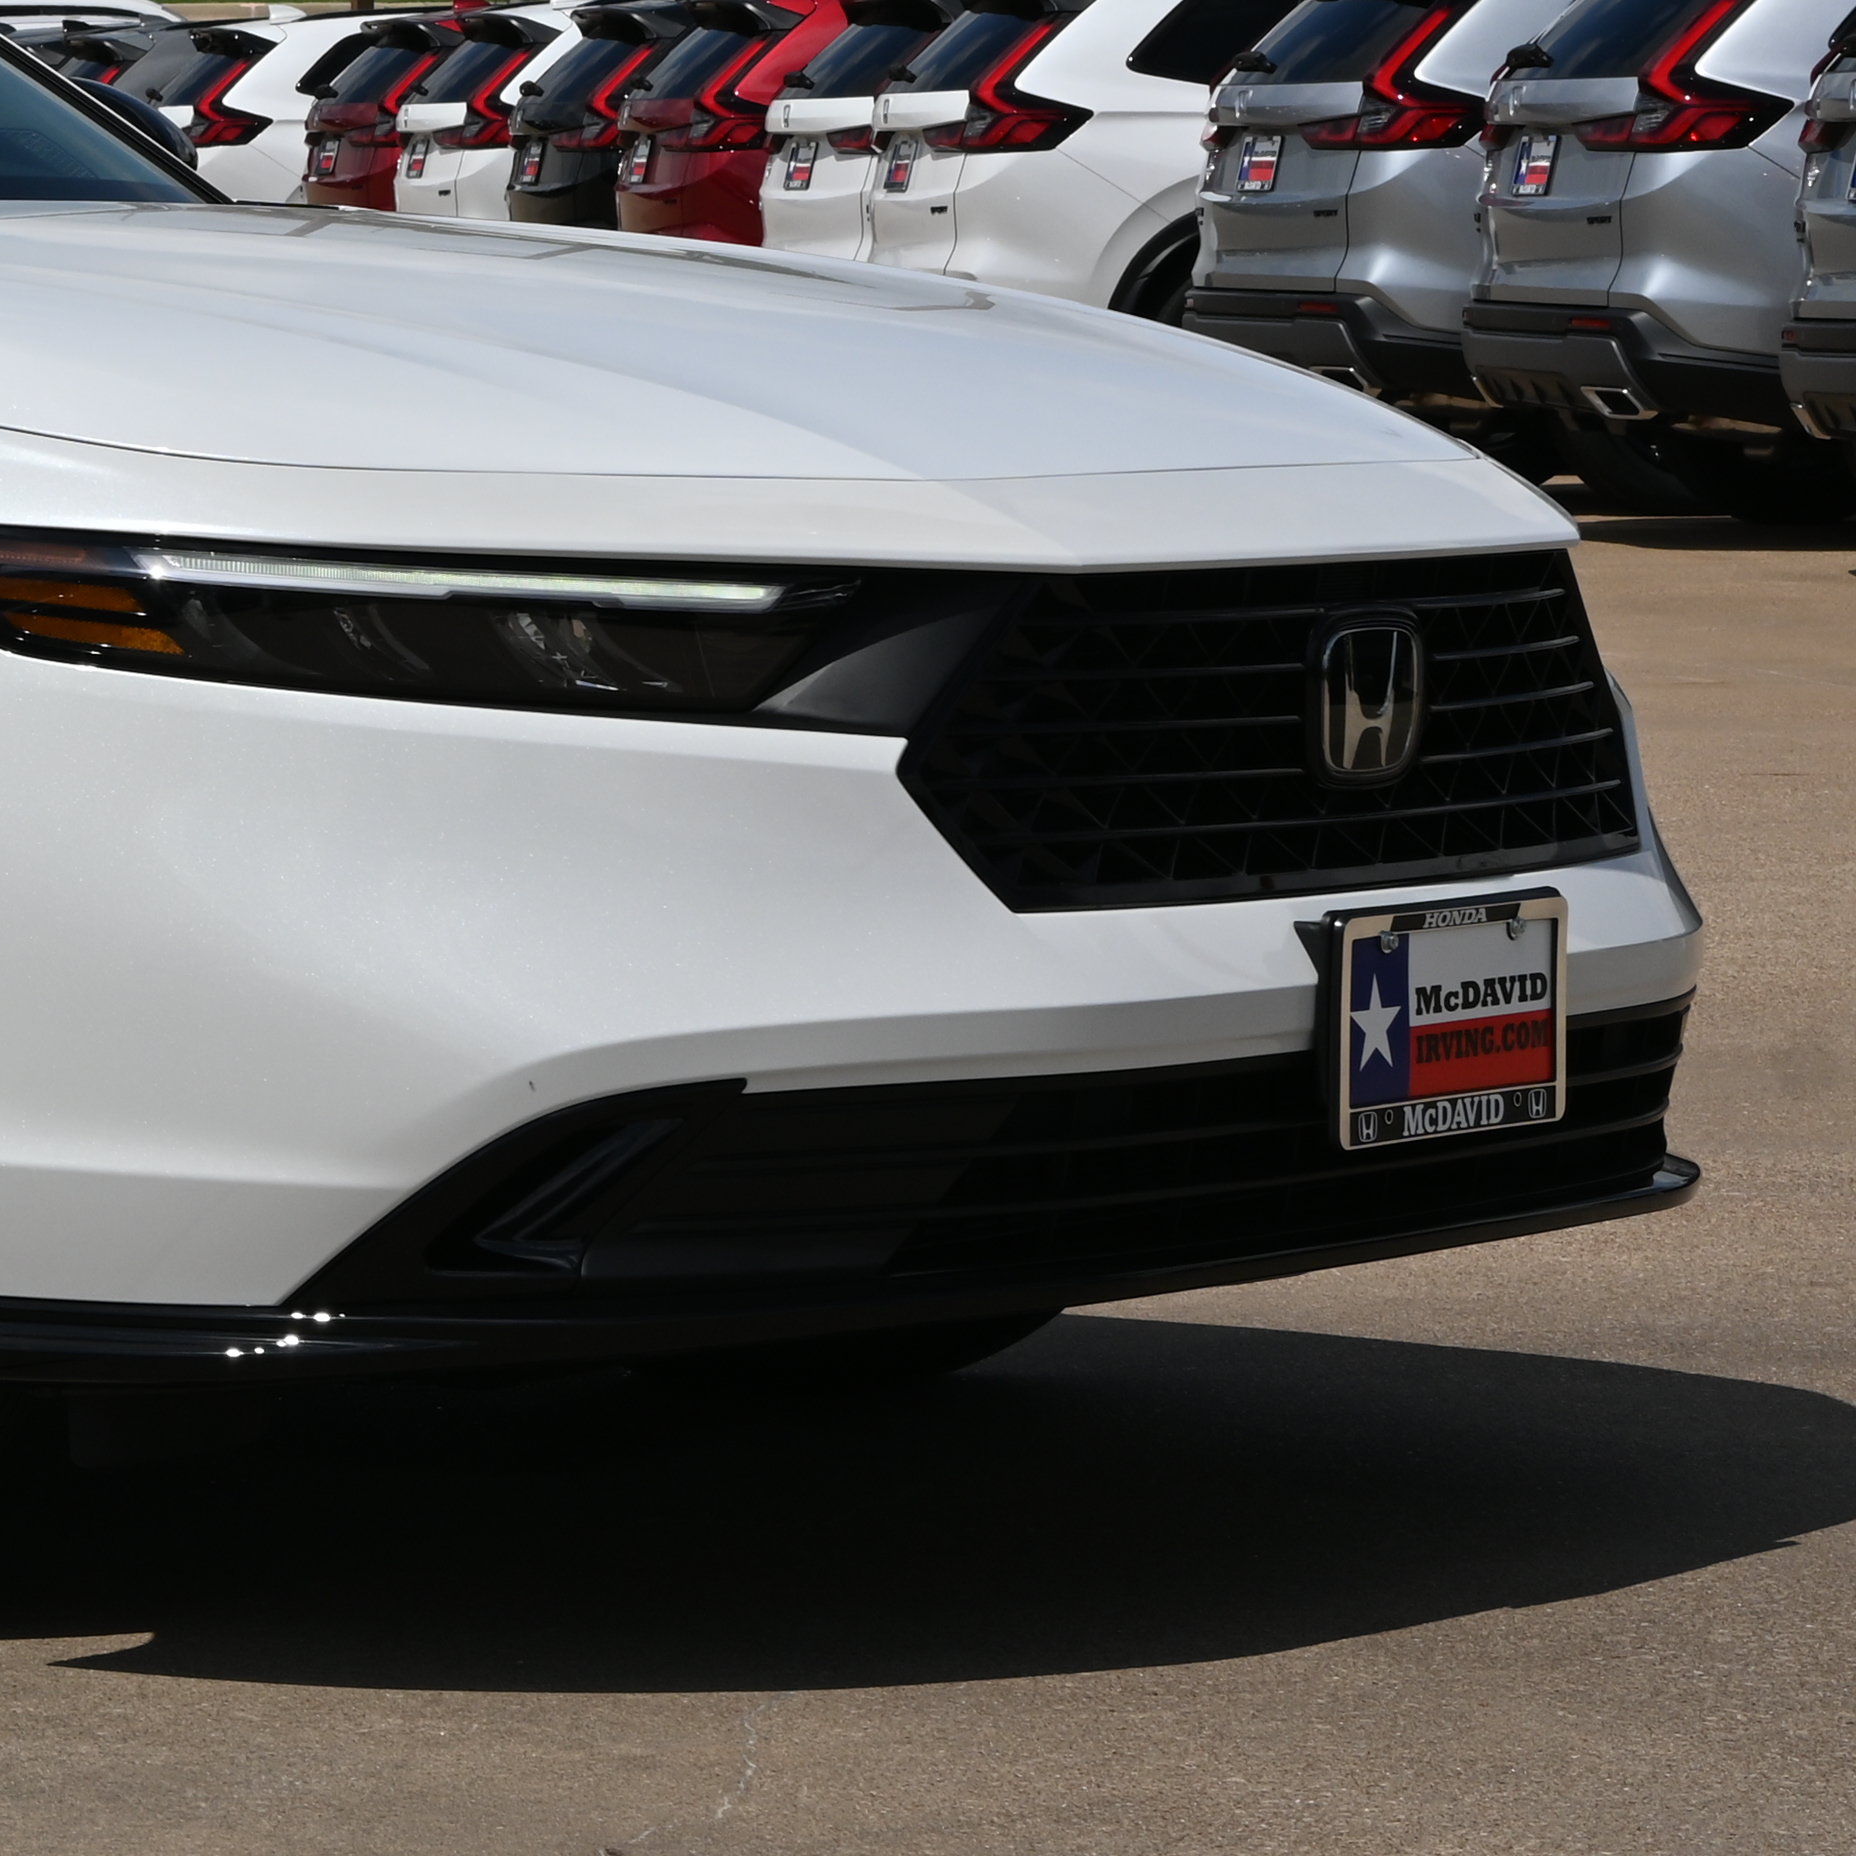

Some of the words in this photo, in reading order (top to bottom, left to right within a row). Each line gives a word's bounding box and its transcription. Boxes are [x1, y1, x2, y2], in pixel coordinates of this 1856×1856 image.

[1422, 907, 1488, 929] HONDA
[1414, 972, 1548, 1016] McDAVID
[1415, 1017, 1550, 1065] IRVING.COM
[1402, 1094, 1505, 1137] McDAVID
